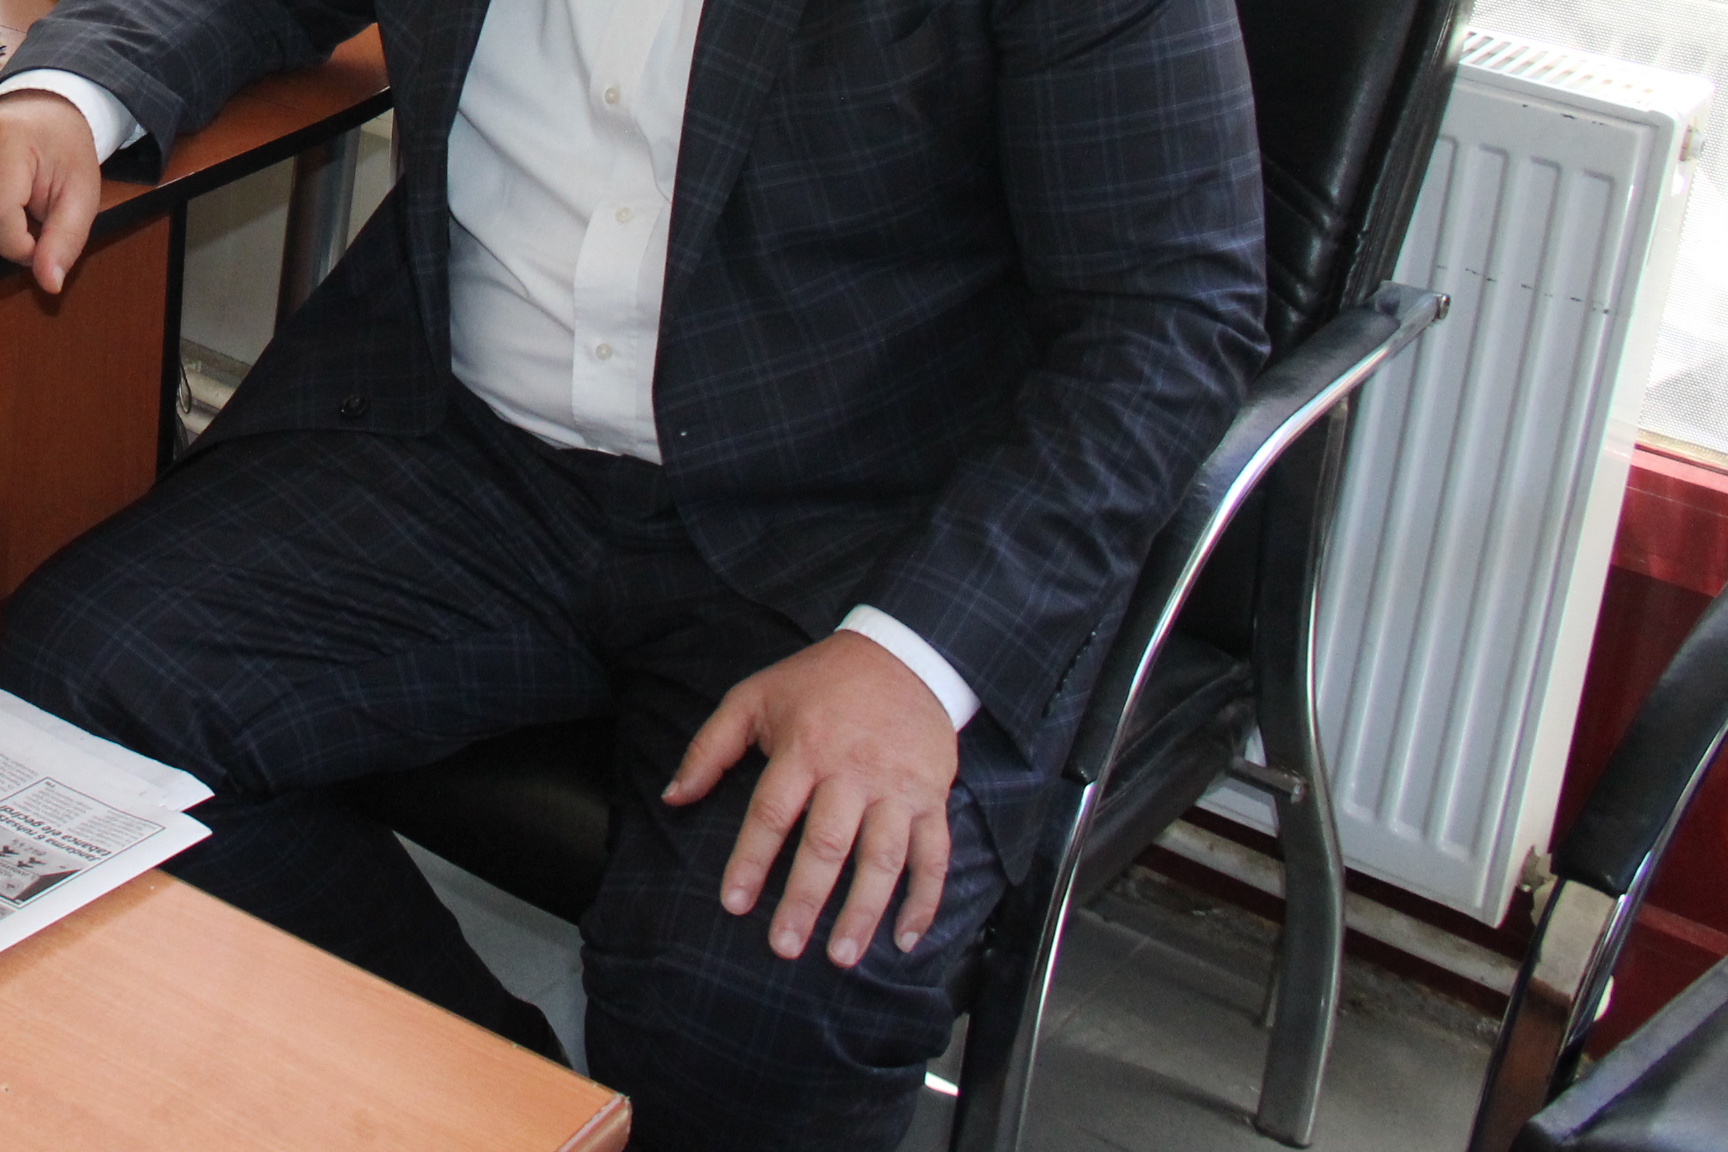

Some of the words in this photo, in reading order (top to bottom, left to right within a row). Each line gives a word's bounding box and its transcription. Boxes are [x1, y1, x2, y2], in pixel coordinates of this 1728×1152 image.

[40, 825, 63, 837] ele
[44, 837, 101, 862] Jandarma
[60, 834, 112, 857] tabanca
